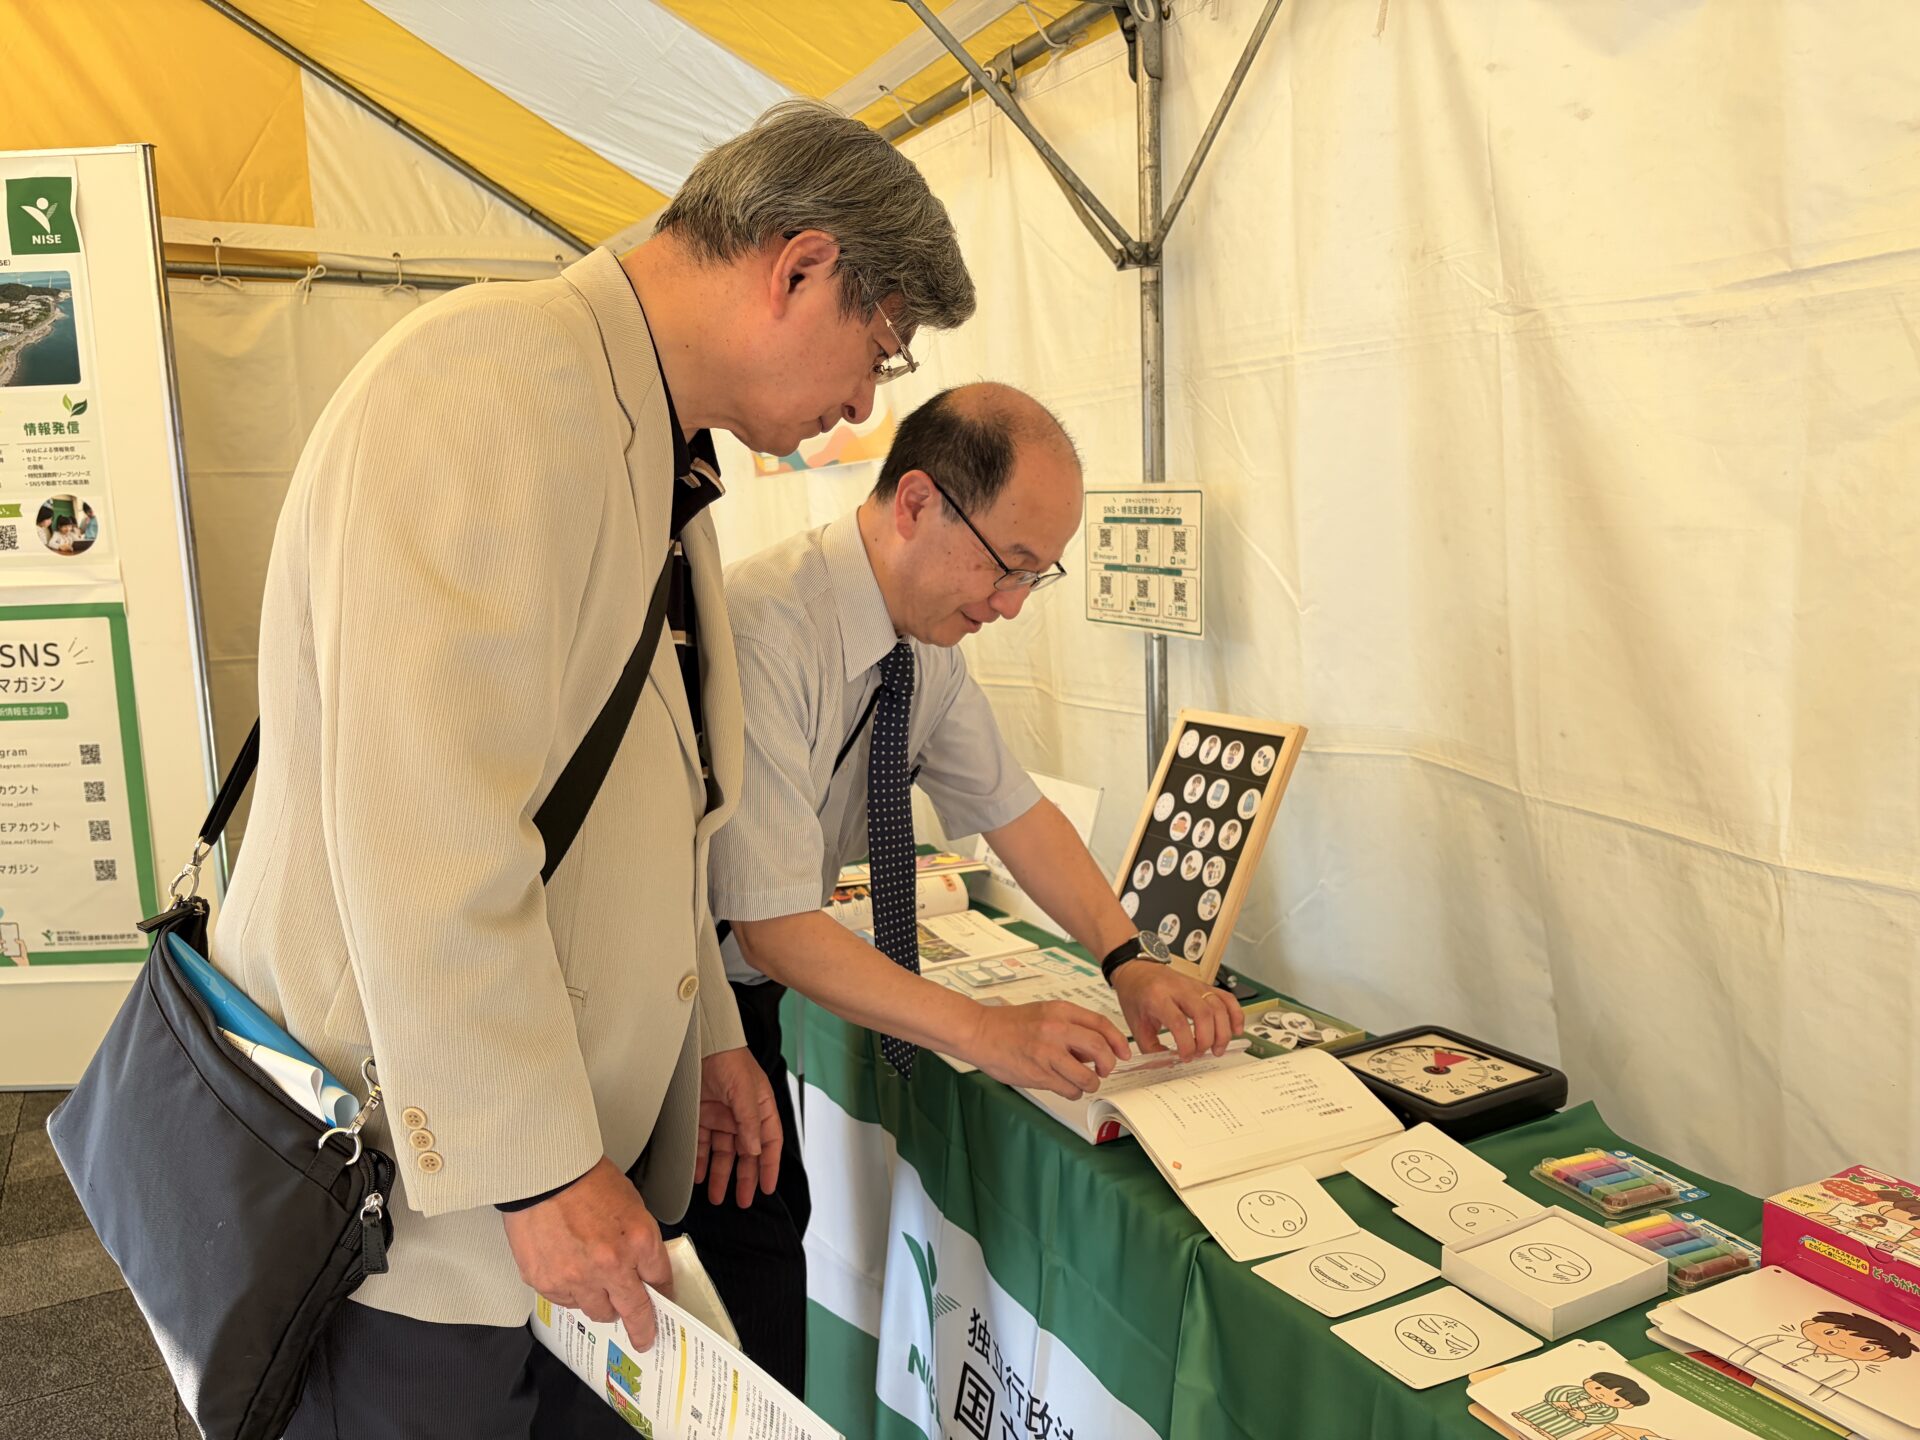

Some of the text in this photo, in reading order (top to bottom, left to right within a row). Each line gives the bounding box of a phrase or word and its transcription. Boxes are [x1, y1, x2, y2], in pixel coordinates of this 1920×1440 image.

[32, 234, 62, 245] NISE
[23, 421, 80, 436] 情報発信
[0, 642, 60, 668] SNS
[0, 676, 64, 694] マガジン
